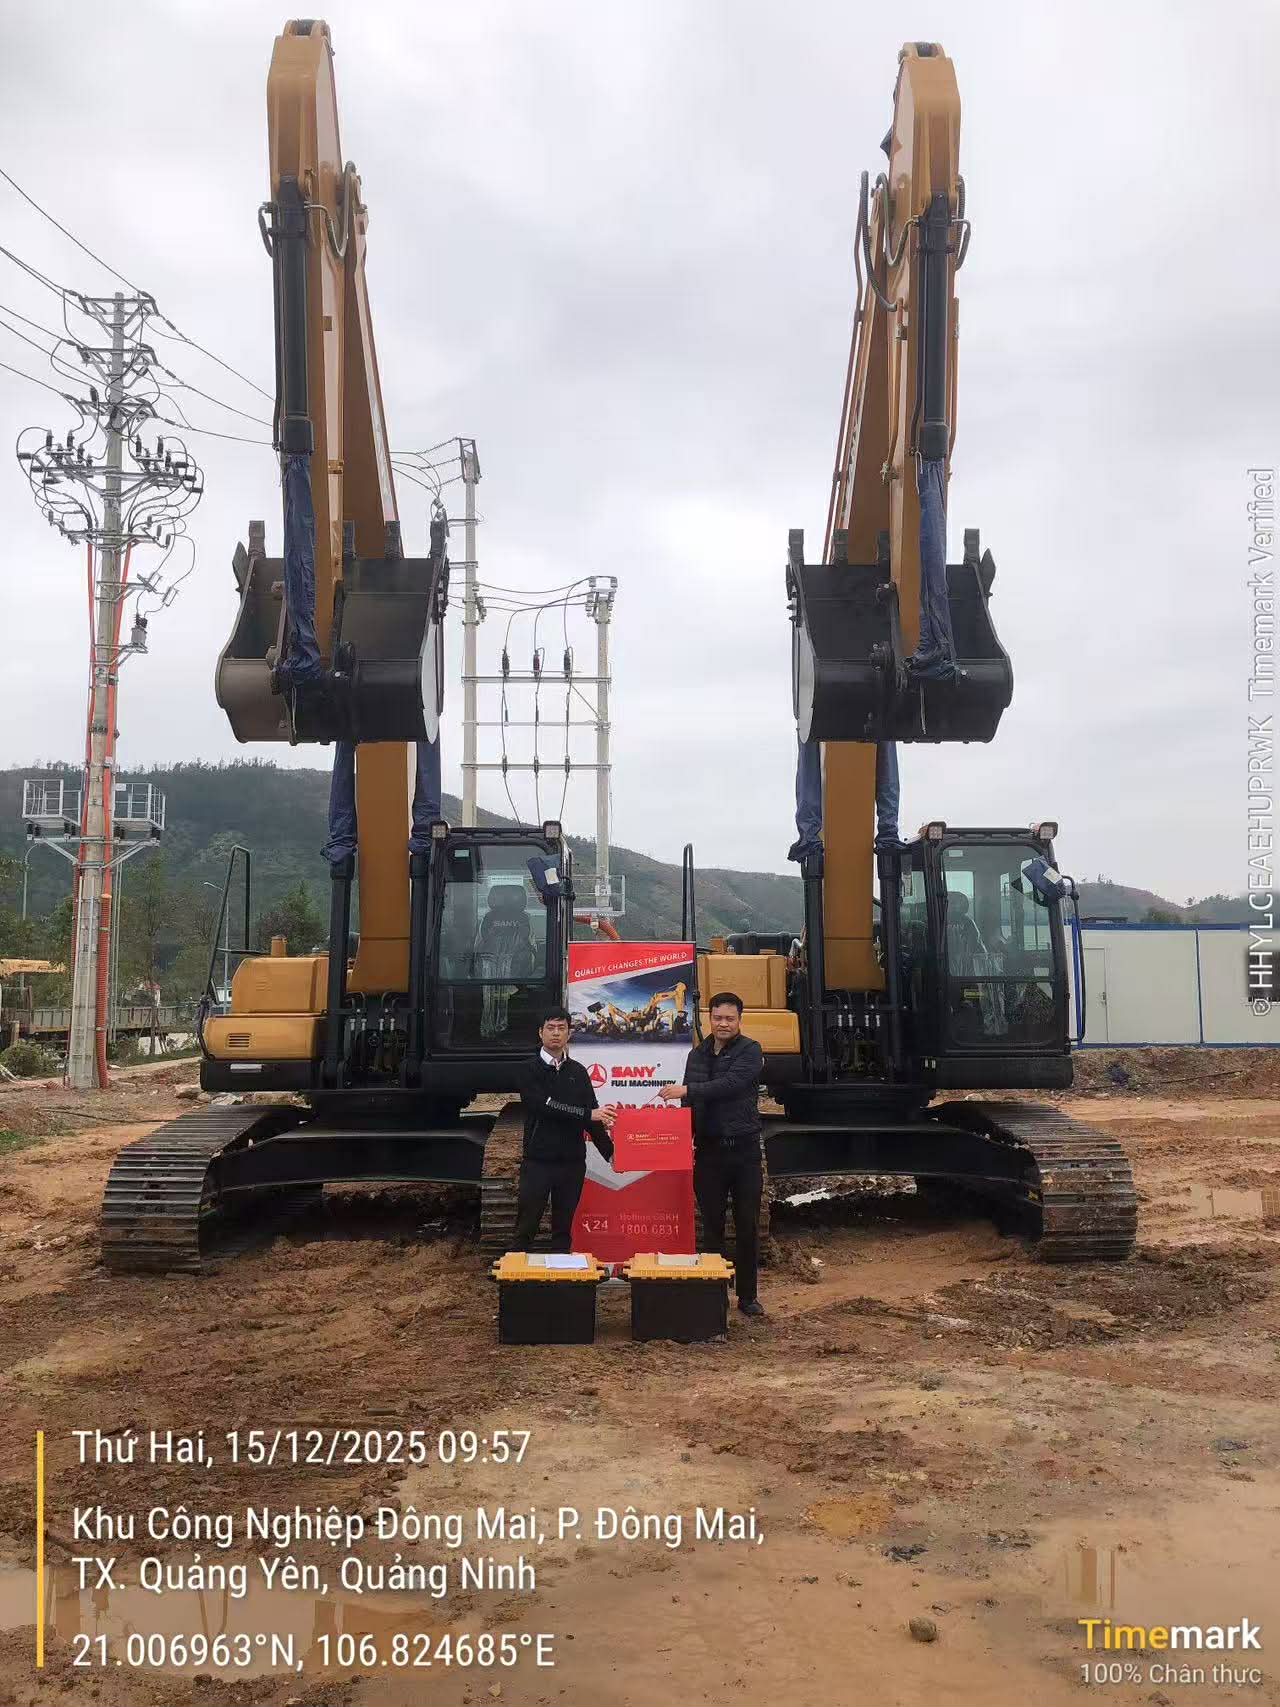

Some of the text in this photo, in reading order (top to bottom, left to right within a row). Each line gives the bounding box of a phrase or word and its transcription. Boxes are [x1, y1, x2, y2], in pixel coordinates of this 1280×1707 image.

[574, 951, 688, 978] QUALITY CHANGES THE WORLD
[611, 1066, 656, 1078] SANY
[611, 1080, 628, 1088] FULI
[621, 1223, 679, 1235] 1800 6831
